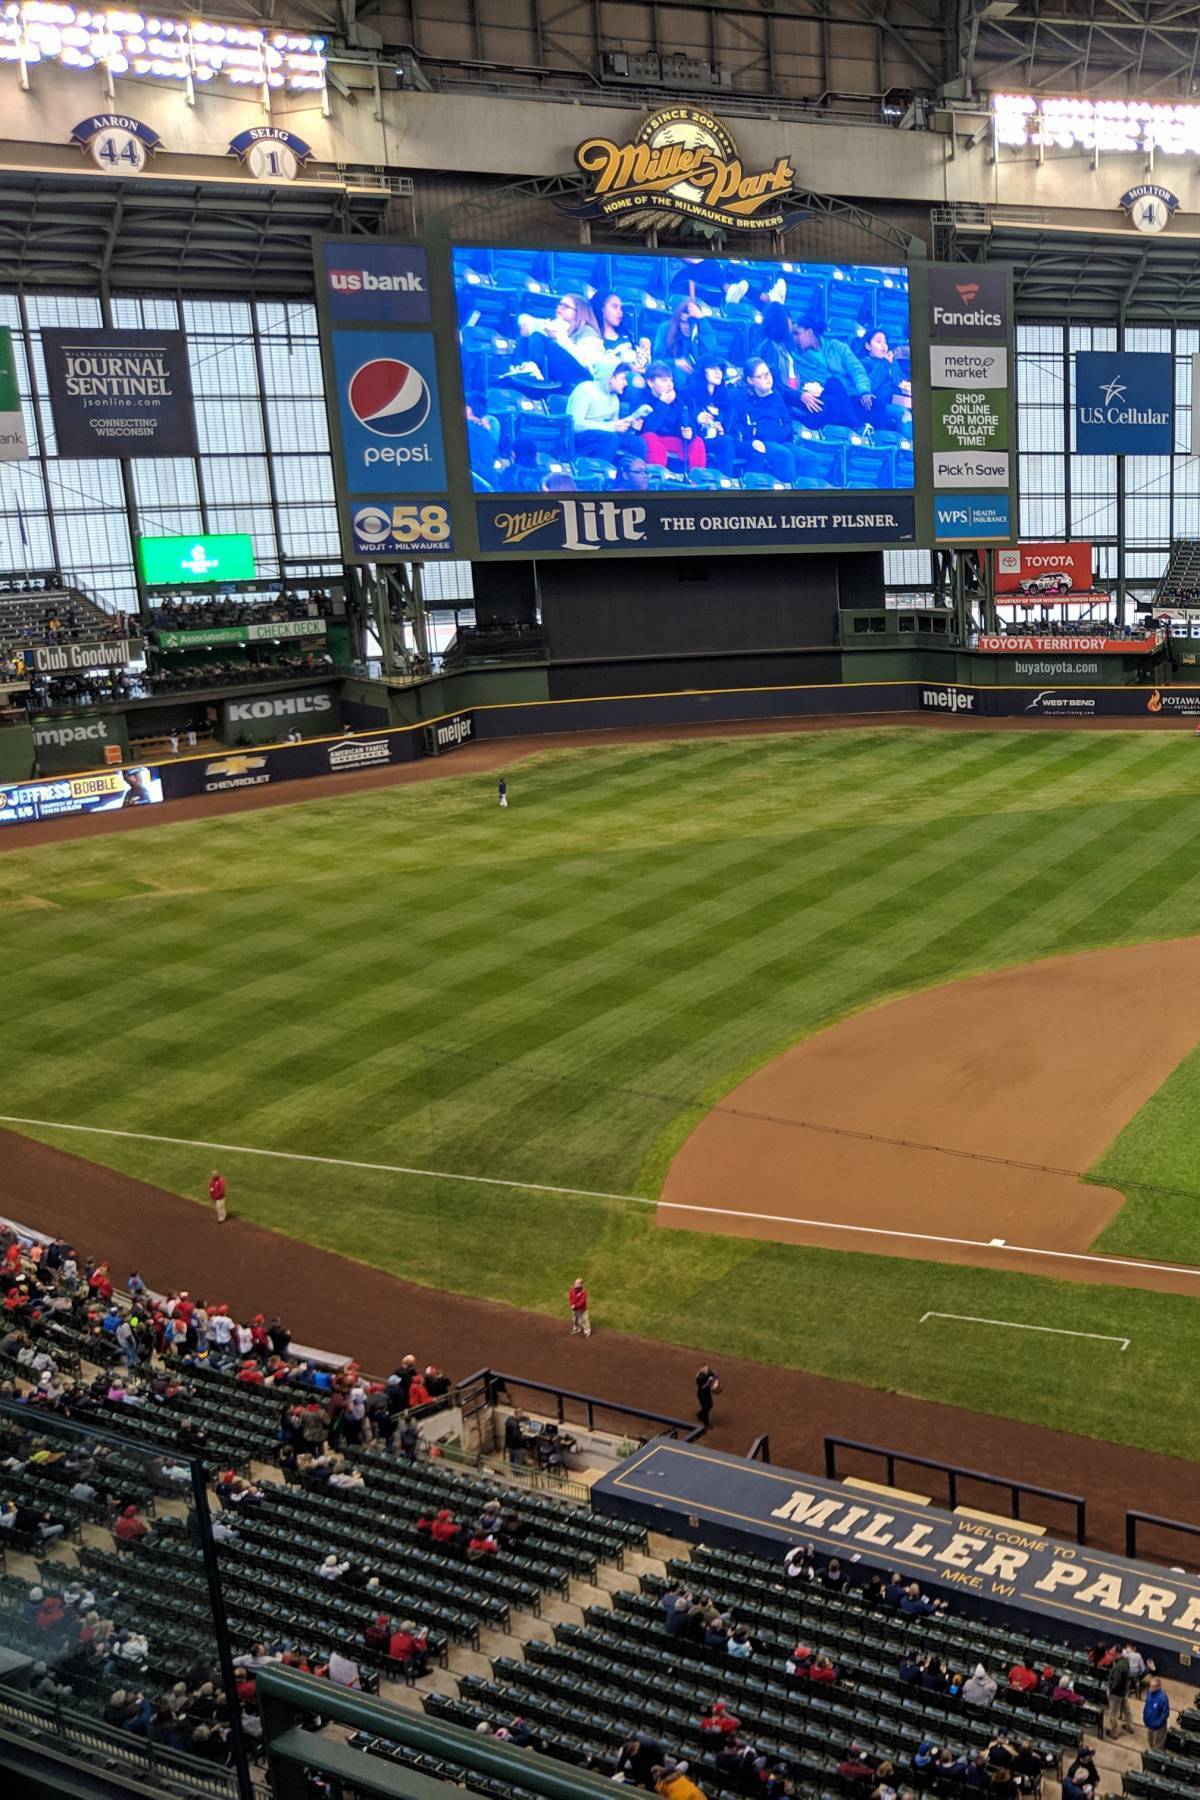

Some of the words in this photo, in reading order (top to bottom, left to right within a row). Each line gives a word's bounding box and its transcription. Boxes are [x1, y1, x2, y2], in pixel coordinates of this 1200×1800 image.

[92, 116, 139, 131] AARON
[650, 110, 688, 129] SINCE
[691, 112, 719, 133] 2001
[249, 128, 289, 141] SELIG
[99, 136, 141, 166] 44
[266, 151, 284, 177] 1
[578, 140, 715, 194] Miller
[689, 156, 794, 207] Park
[1128, 186, 1172, 201] MOLITOR
[604, 197, 633, 214] HOME
[634, 195, 648, 205] OF
[651, 196, 672, 207] THE
[674, 200, 734, 226] MILWAUKEE
[736, 215, 784, 228] BREWERS
[1142, 203, 1156, 225] 4
[933, 307, 1002, 326] Fanatics
[65, 358, 170, 377] JOURNAL
[945, 355, 982, 366] metro
[945, 367, 988, 379] market
[66, 377, 173, 396] SENTINEL
[83, 398, 161, 409] jsonline.com
[955, 393, 986, 404] SHOP
[950, 404, 991, 415] ONLINE
[1079, 407, 1106, 425] U.S.
[1106, 407, 1170, 425] Cellular
[89, 418, 158, 429] CONNECTING
[942, 415, 966, 425] FOR
[967, 415, 999, 426] MORE
[95, 427, 155, 437] WISCONSIN
[946, 425, 996, 436] TAILGATE
[957, 436, 986, 446] TIME!
[364, 443, 431, 466] pepsi
[975, 464, 1006, 477] Save
[391, 505, 451, 541] 58
[495, 508, 560, 544] Miller
[558, 500, 647, 550] Lite
[660, 516, 696, 531] THE
[699, 514, 777, 530] ORIGINAL
[781, 514, 827, 529] LIGHT
[832, 513, 898, 528] PILSNER.
[937, 510, 968, 524] WPS
[973, 509, 996, 517] HEALTH
[973, 515, 1008, 524] INSURANCE
[358, 543, 386, 552] WDJT
[395, 541, 451, 551] MILWAUKEE
[1025, 555, 1075, 567] TOYOTA
[1043, 597, 1070, 605] WISCONSIN
[257, 623, 292, 638] CHECK
[294, 621, 320, 636] DECK
[981, 638, 1033, 650] TOYOTA
[1035, 637, 1107, 650] TERRITORY
[36, 649, 69, 671] Club
[71, 641, 130, 667] Goodwill
[1015, 661, 1098, 675] buyatoyota.com
[229, 695, 332, 721] KOHL'S
[923, 688, 975, 712] meijer
[1069, 699, 1095, 707] BEND
[32, 720, 107, 747] impact
[437, 717, 472, 745] meijer
[330, 746, 364, 757] AMERICAN
[365, 743, 388, 754] FAMILY
[206, 774, 271, 791] CHEVROLET
[7, 783, 72, 806] JEFFRESS
[73, 777, 117, 795] BOBBLE
[770, 1492, 1030, 1583] MILLER
[958, 1520, 1049, 1552] WELCOME
[1053, 1546, 1077, 1559] TO
[940, 1569, 984, 1591] MKE,
[991, 1582, 1016, 1597] WI
